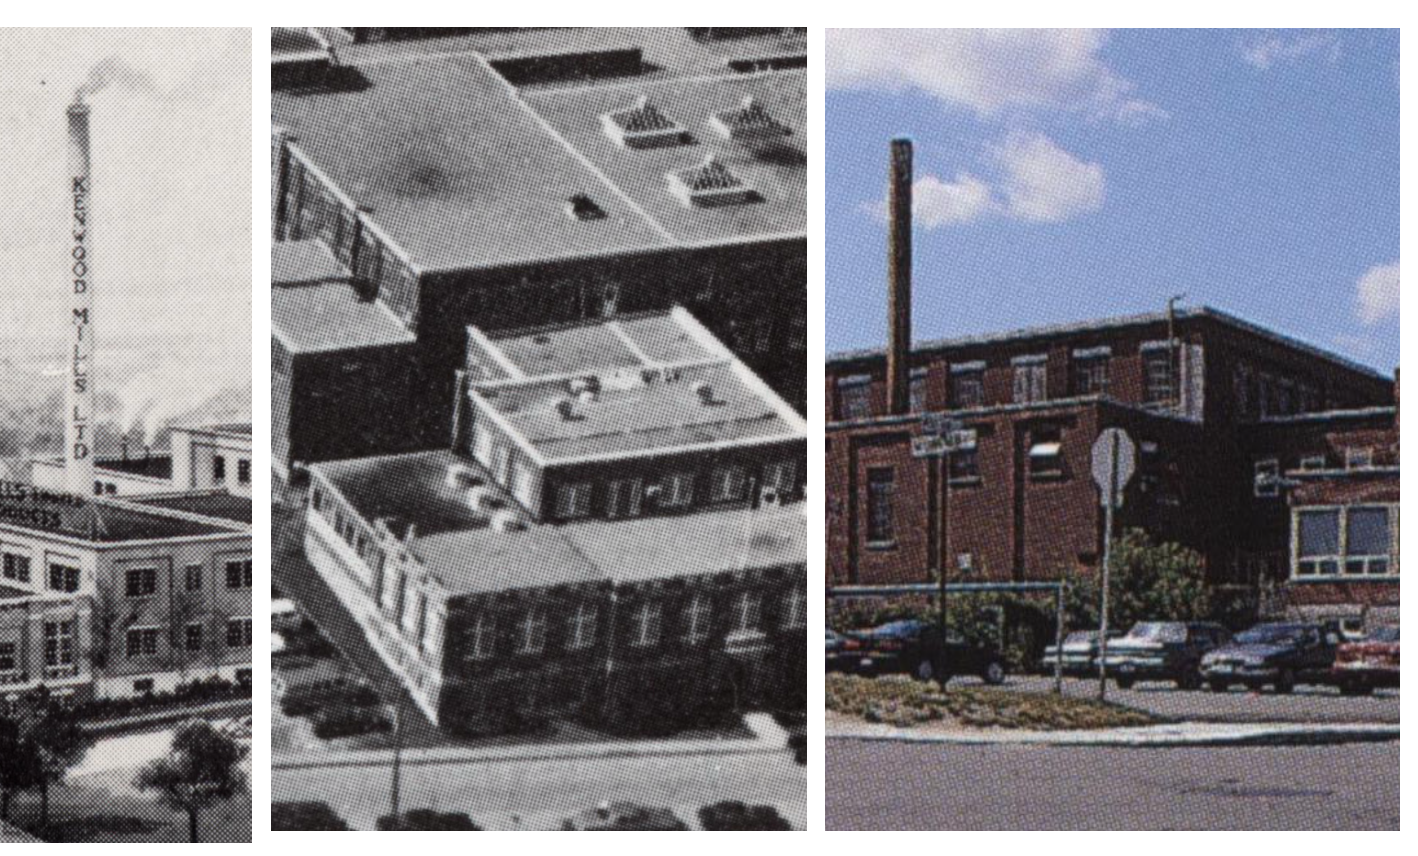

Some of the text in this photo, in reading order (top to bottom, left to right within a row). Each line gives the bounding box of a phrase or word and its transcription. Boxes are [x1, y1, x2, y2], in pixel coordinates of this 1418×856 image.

[71, 176, 90, 459] KENWOOD MILLS LTD
